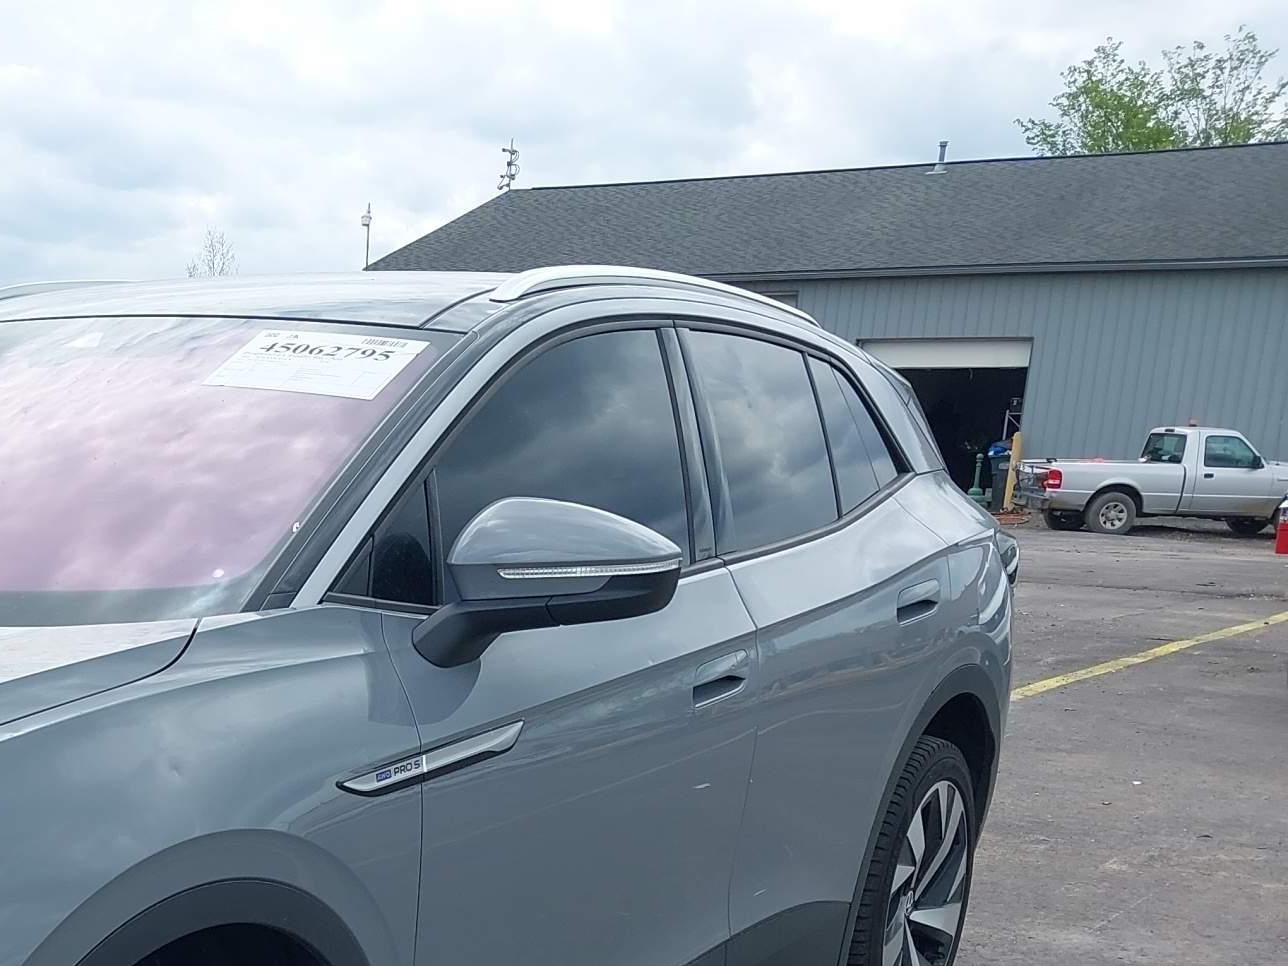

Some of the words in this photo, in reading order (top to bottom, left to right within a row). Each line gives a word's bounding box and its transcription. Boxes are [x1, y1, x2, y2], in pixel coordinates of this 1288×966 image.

[259, 342, 396, 361] 45062795
[394, 762, 412, 776] PRO
[413, 759, 421, 770] S
